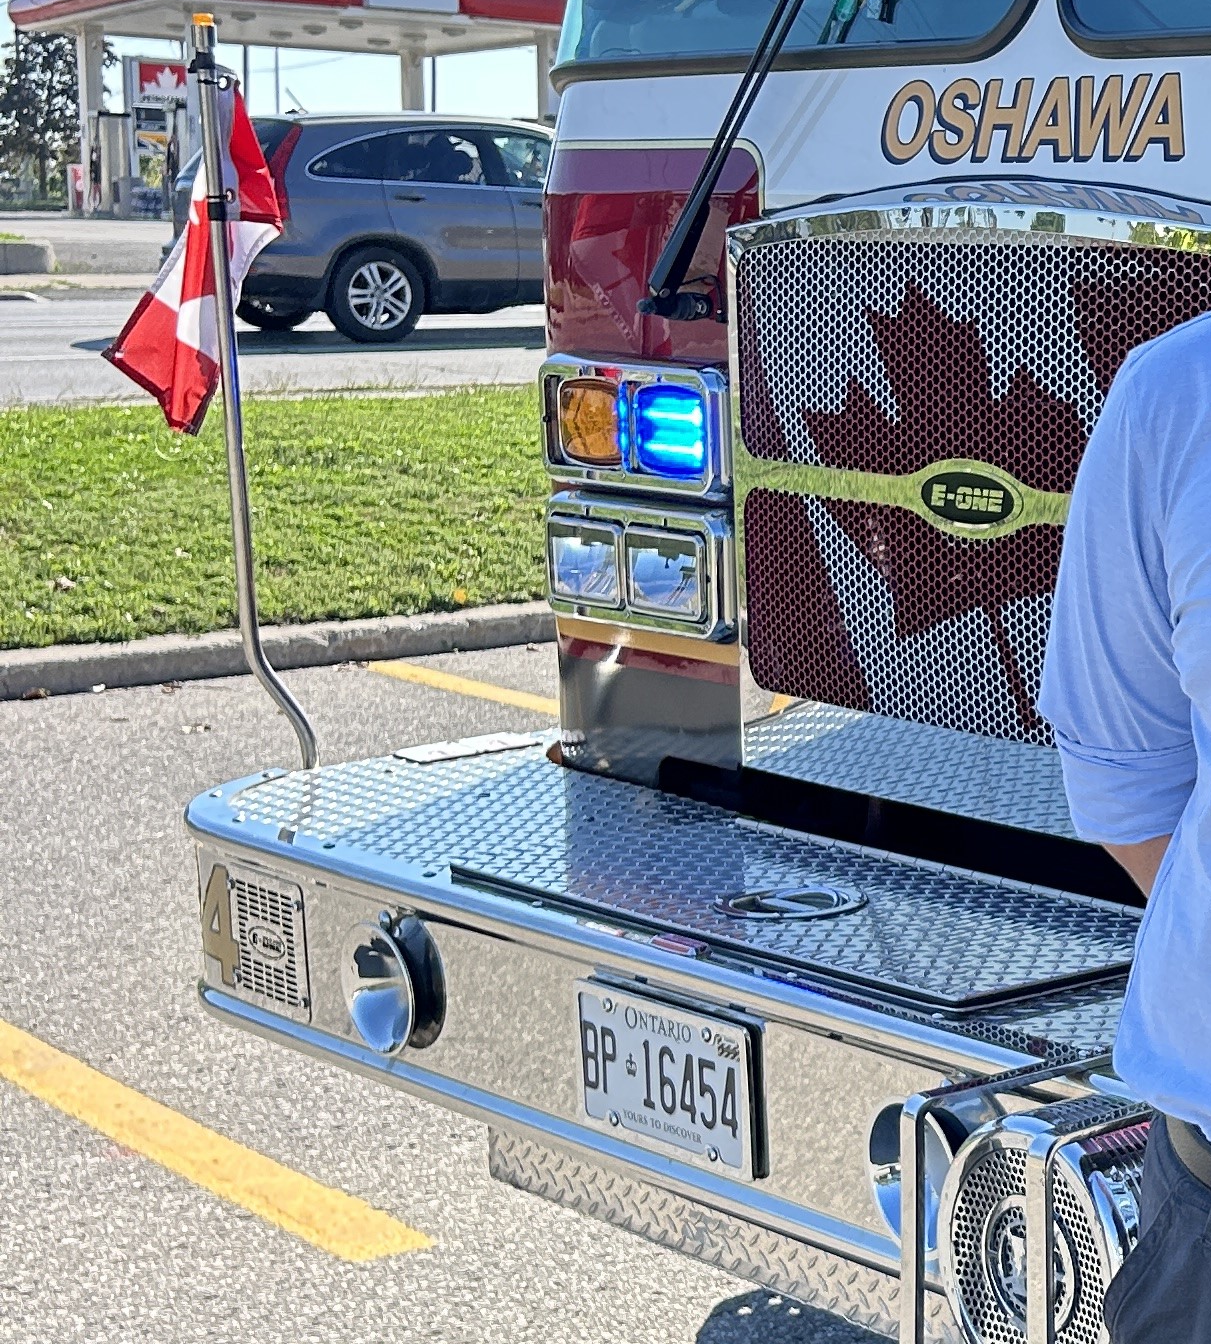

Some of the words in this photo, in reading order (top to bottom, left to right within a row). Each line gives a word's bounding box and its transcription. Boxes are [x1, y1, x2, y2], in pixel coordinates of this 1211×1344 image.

[880, 71, 1186, 166] OSHAWA
[930, 483, 1004, 513] E-ONE
[201, 862, 242, 990] 4
[624, 1006, 692, 1044] ONTARIO
[582, 1019, 617, 1094] BP
[642, 1038, 739, 1139] 16454
[622, 1108, 648, 1126] YOURS
[650, 1116, 662, 1130] TO
[663, 1121, 703, 1145] DISCOVER
